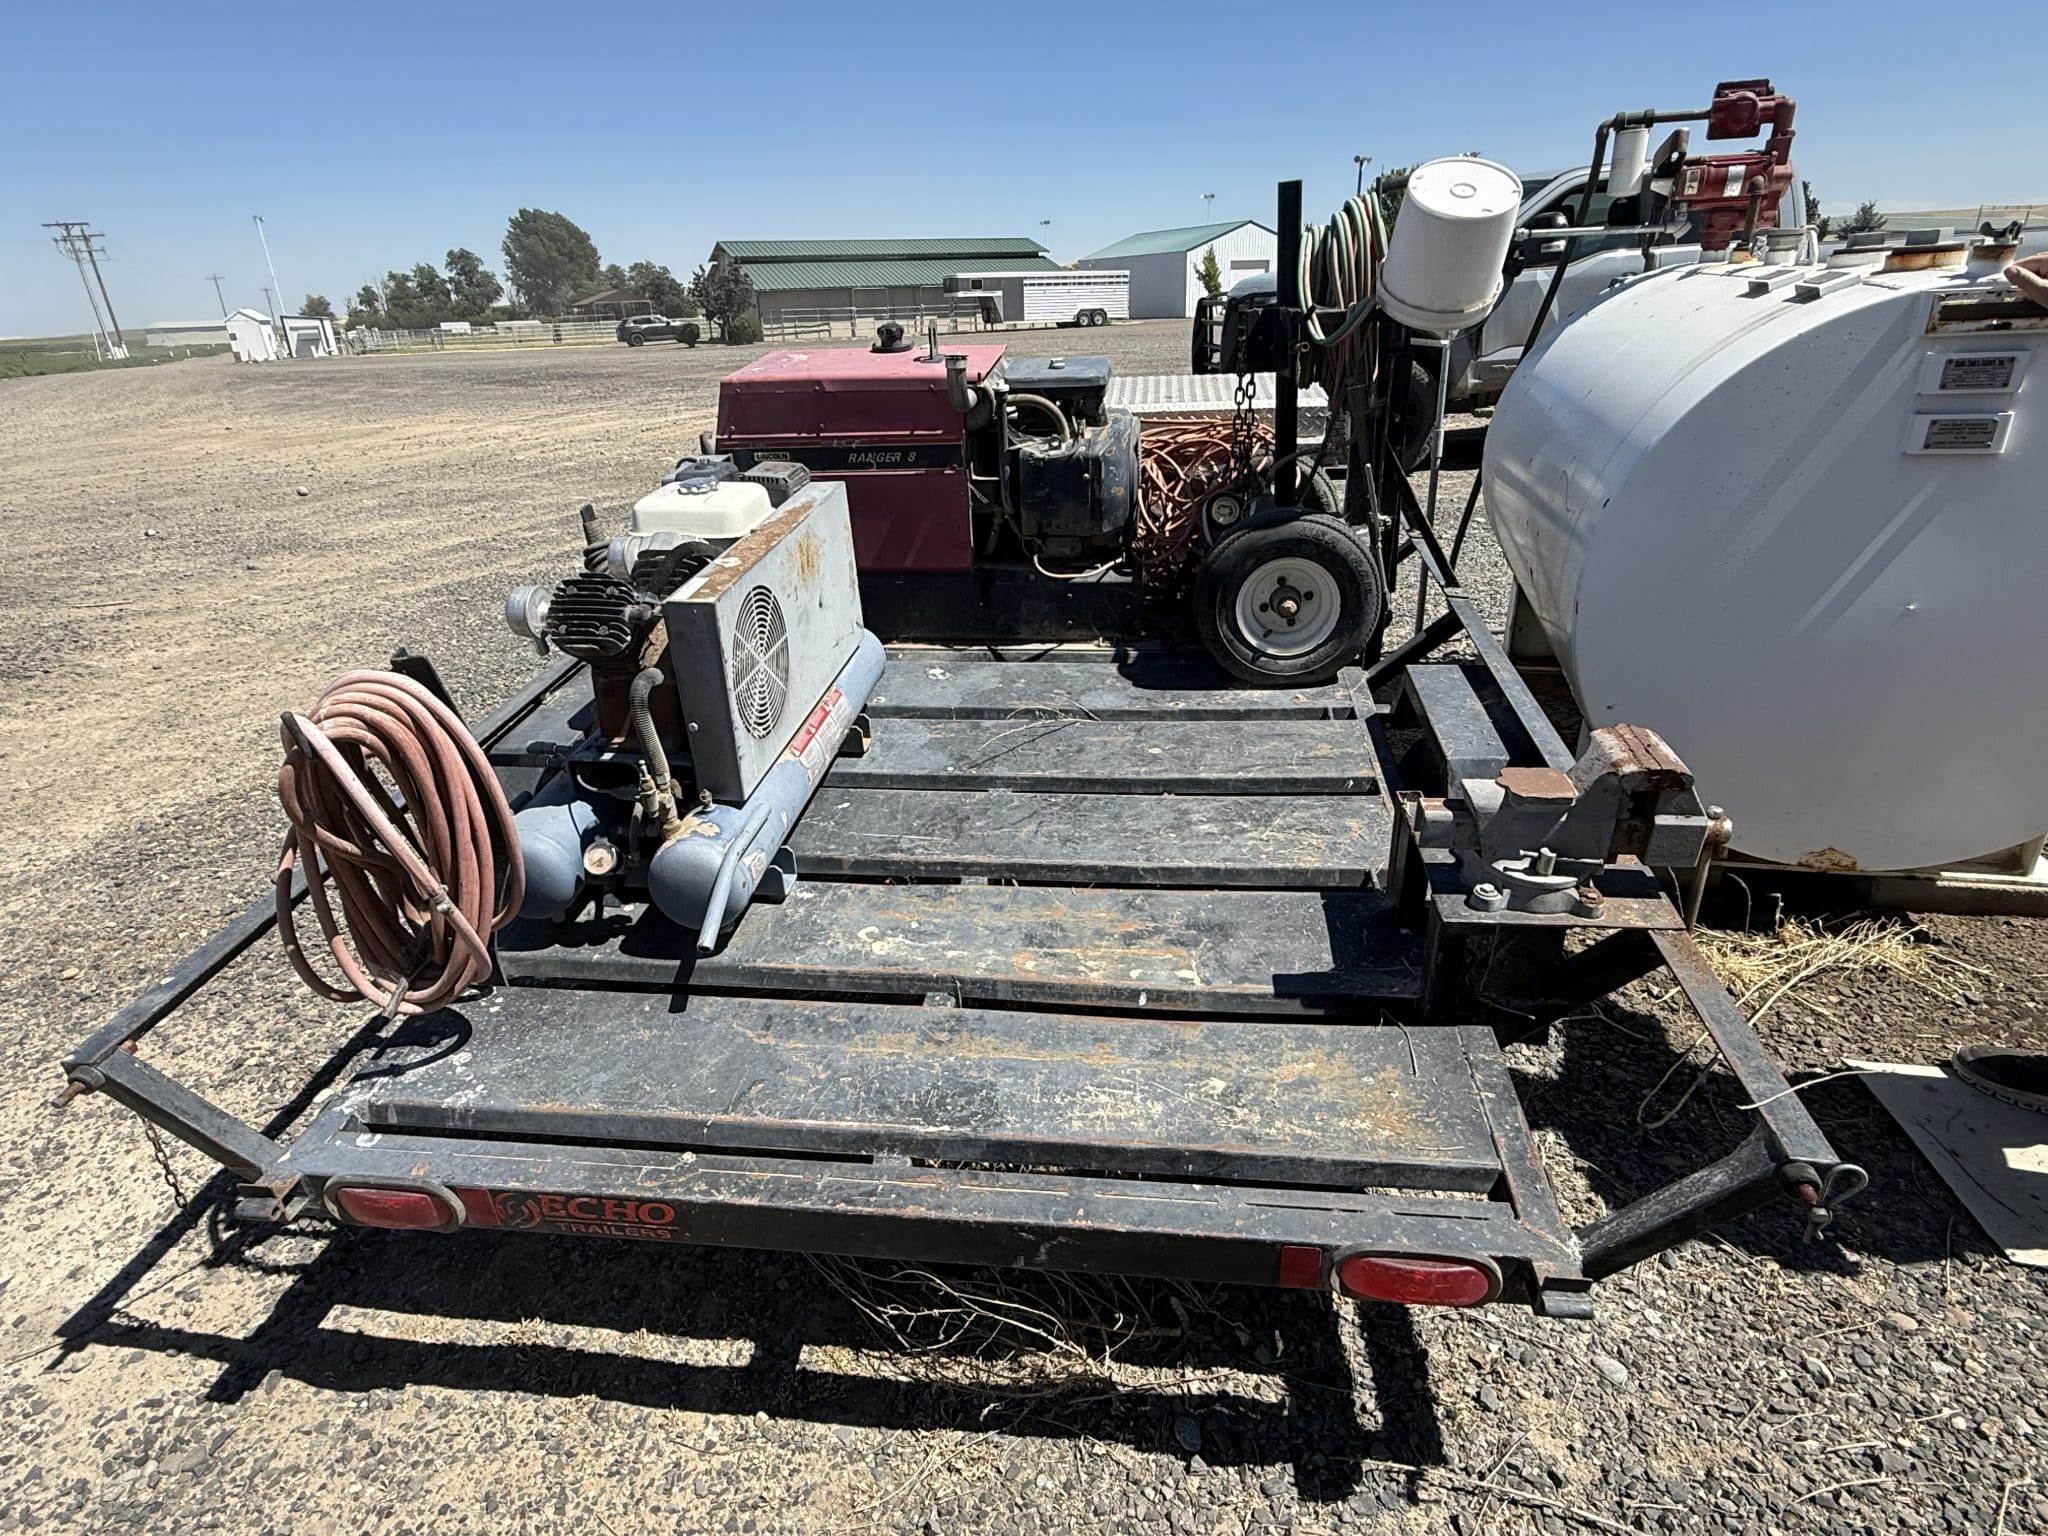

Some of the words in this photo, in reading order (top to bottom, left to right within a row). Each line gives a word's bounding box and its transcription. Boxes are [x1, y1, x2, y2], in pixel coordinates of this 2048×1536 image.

[755, 452, 789, 460] LINCOLN
[848, 452, 901, 463] RANGER
[907, 452, 917, 462] 8
[537, 1194, 675, 1225] ECHO
[557, 1222, 672, 1239] TRAILERS
